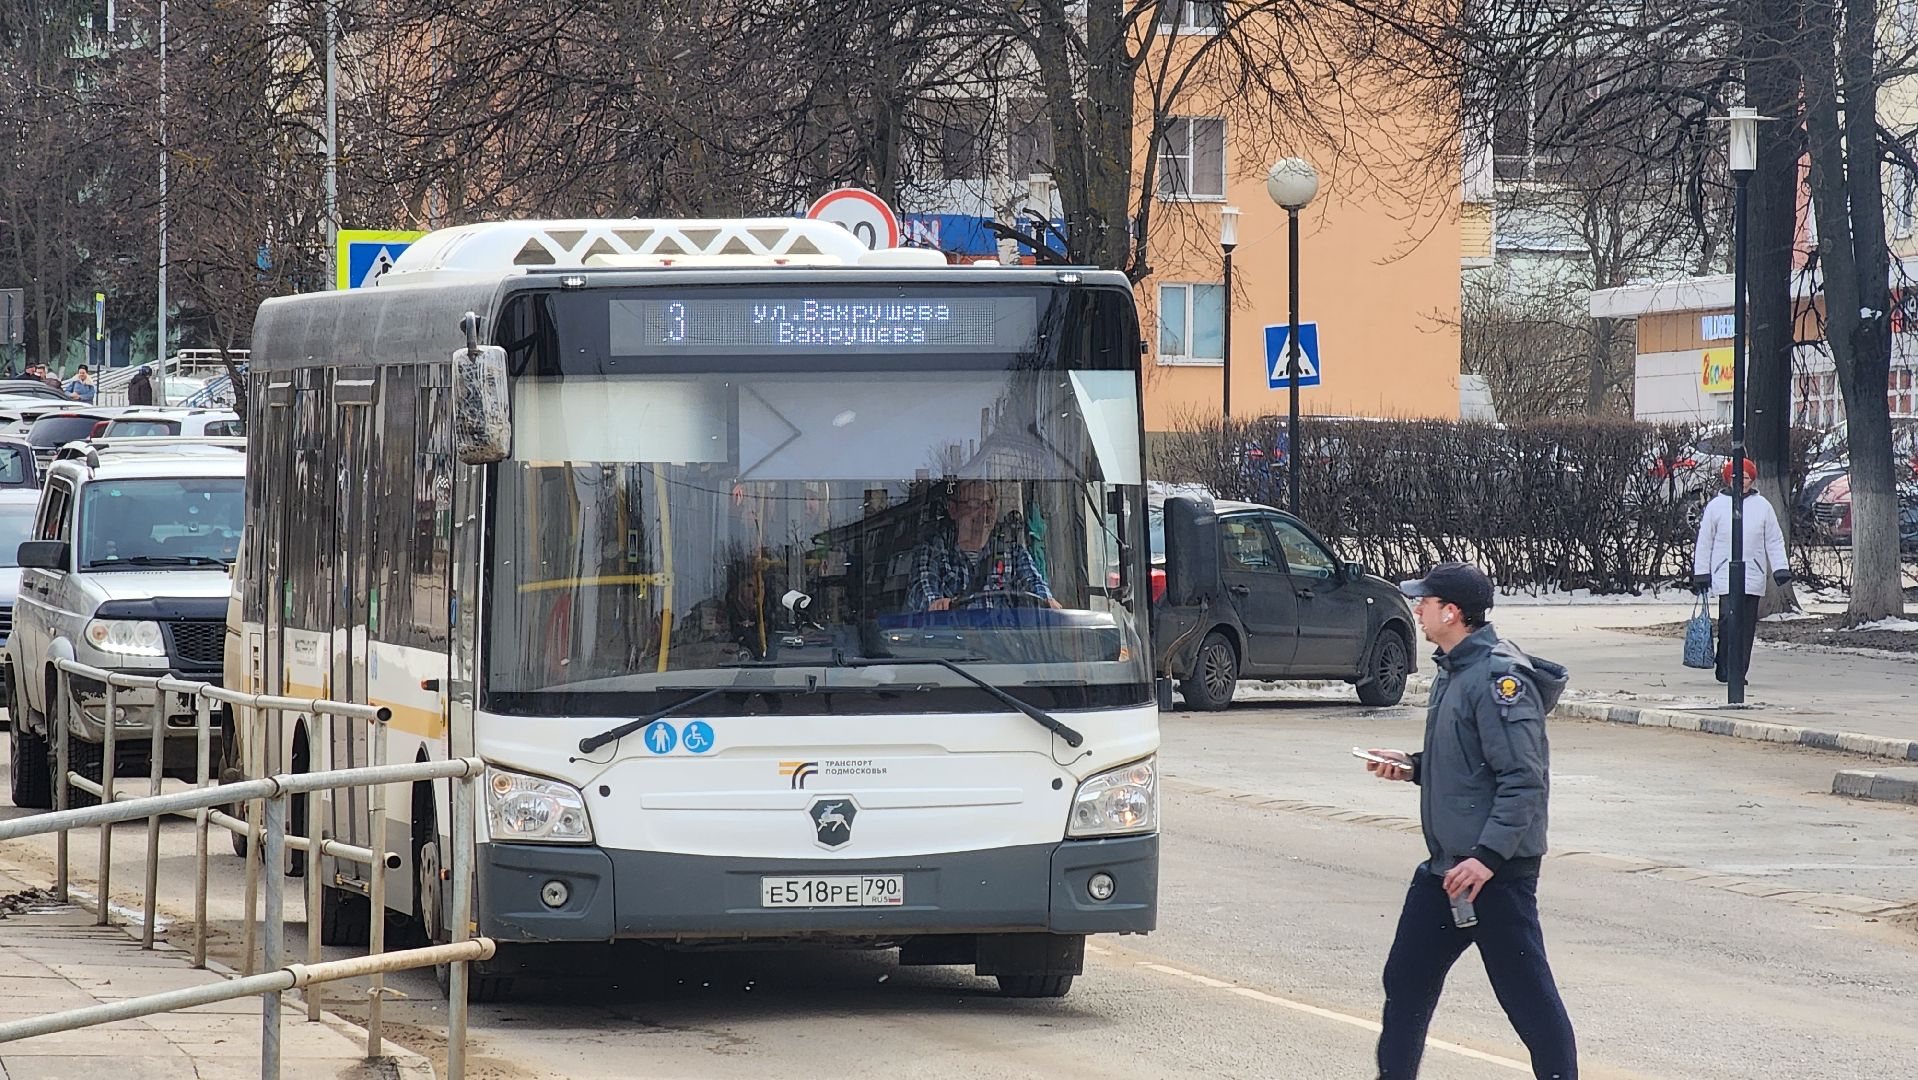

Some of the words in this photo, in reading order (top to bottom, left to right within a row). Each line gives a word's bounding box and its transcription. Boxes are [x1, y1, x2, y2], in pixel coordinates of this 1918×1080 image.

[669, 303, 685, 341] 3
[753, 299, 949, 323] ул.Вахрушева
[779, 321, 925, 345] Вахрушева
[825, 760, 873, 768] ТРАНСПОРТ
[825, 767, 888, 775] ПОДМОСКОВЬЯ
